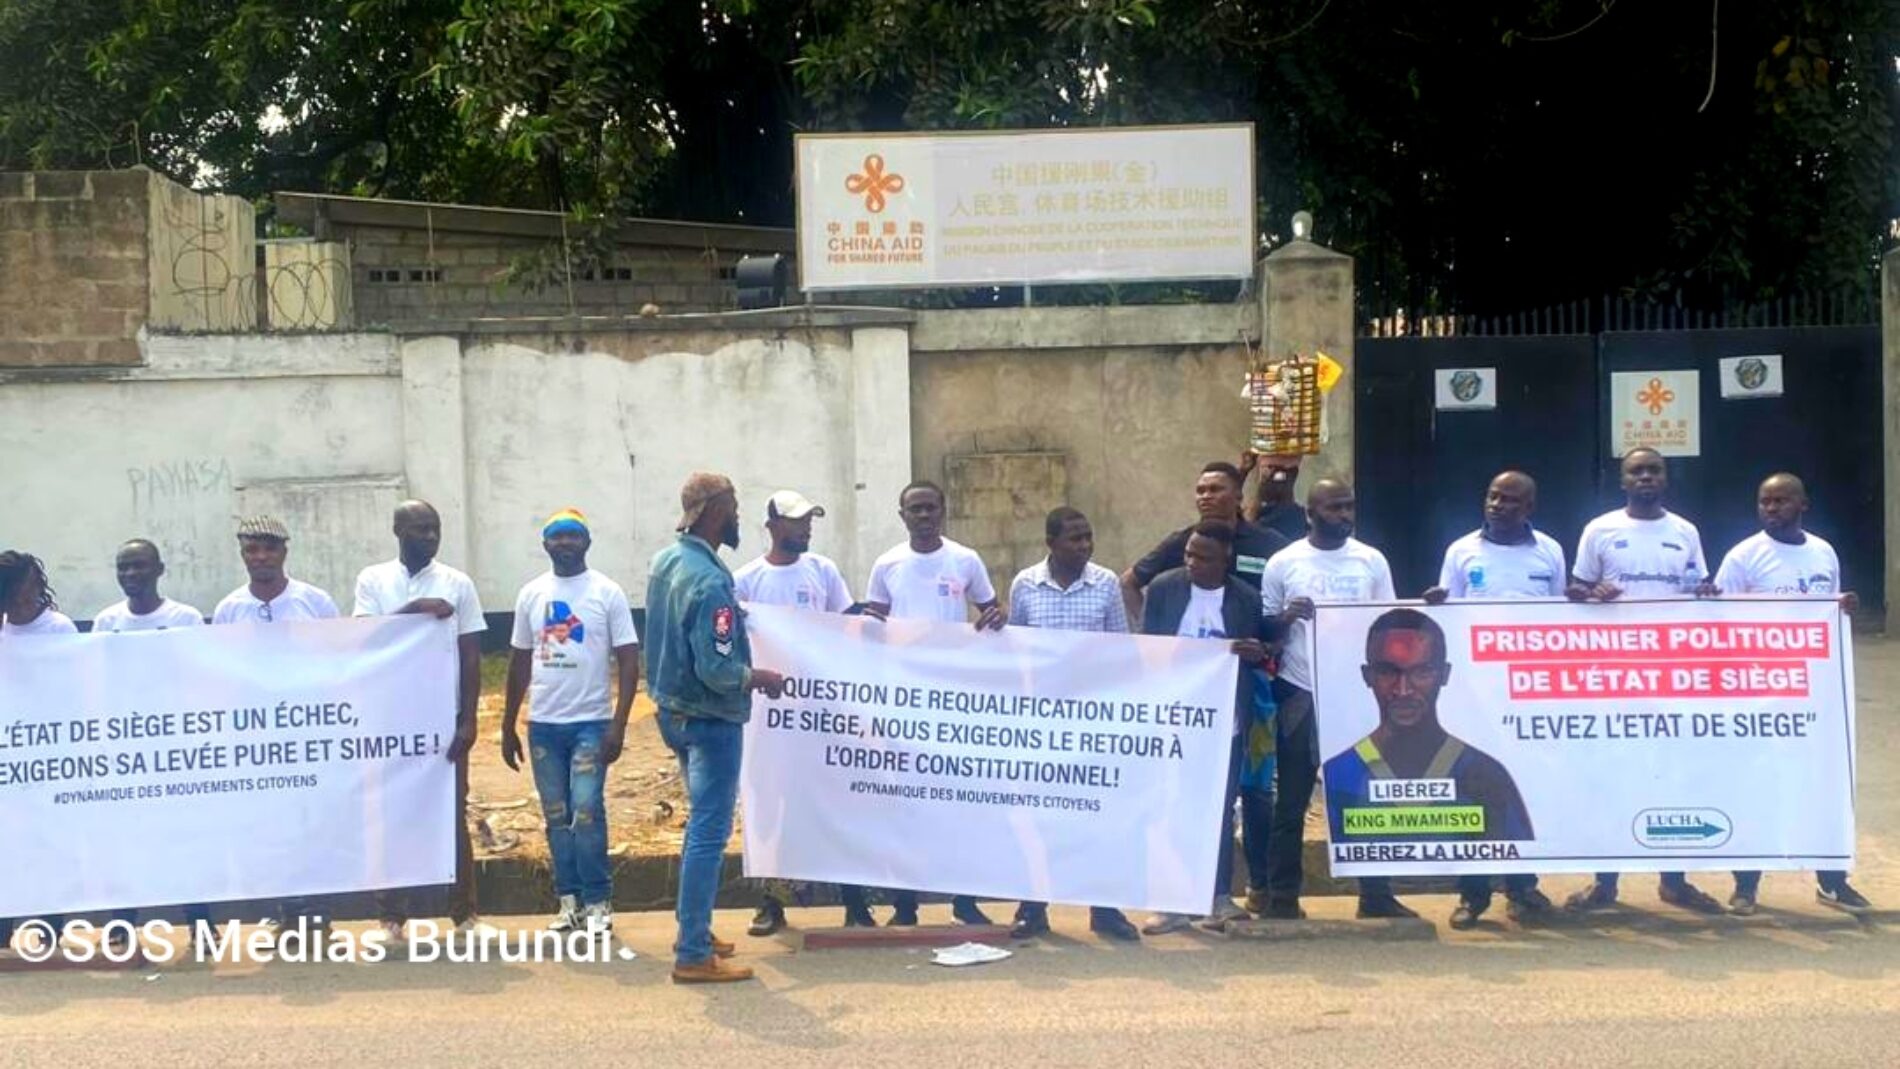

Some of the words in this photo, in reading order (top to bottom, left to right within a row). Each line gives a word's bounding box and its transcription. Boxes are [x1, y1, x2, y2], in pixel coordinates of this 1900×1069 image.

[828, 237, 885, 251] CHINA
[892, 237, 923, 250] AID
[1477, 630, 1660, 652] PRISONNIER
[1667, 626, 1825, 650] POLITIQUE
[1512, 670, 1550, 693] DE
[1561, 665, 1662, 692] L'ÉTAT
[1672, 669, 1712, 691] DE
[1720, 663, 1808, 690] SIÈGE
[783, 676, 888, 705] QUESTION
[895, 687, 922, 708] DE
[928, 690, 1114, 722] REQUALIFICATION
[1121, 703, 1149, 723] DE
[1155, 700, 1217, 729] L'ÉTAT
[70, 719, 100, 743] DE
[107, 711, 175, 740] SIÈGE
[183, 710, 226, 735] EST
[233, 708, 267, 731] UN
[275, 701, 359, 728] ÉCHEC,
[767, 708, 794, 729] DE
[800, 708, 865, 738] SIÈGE,
[871, 717, 930, 741] NOUS
[937, 723, 1042, 750] EXIGEONS
[1049, 730, 1074, 751] LE
[1079, 733, 1163, 759] RETOUR
[1169, 733, 1183, 760] À
[1606, 712, 1684, 739] L'ETAT
[1692, 713, 1725, 738] DE
[0, 754, 109, 785] EXIGEONS
[116, 751, 147, 775] SA
[154, 742, 227, 772] LEVÉE
[235, 741, 298, 767] PURE
[305, 739, 333, 763] ET
[340, 734, 426, 760] SIMPLE
[825, 745, 909, 772] L'ORDRE
[915, 752, 1120, 788] CONSTITUTIONNEL!
[54, 786, 136, 804] #DYNAMIQUE
[138, 784, 163, 799] DES
[166, 777, 254, 796] MOUVEMENTS
[256, 774, 318, 791] CITOYENS
[849, 780, 926, 800] #DYNAMIQUE
[930, 786, 955, 801] DES
[956, 789, 1040, 808] MOUVEMENTS
[1043, 796, 1101, 812] CITOYENS
[1374, 781, 1450, 799] LIBÉREZ
[1345, 814, 1386, 828] KING
[1390, 812, 1481, 828] MWAMISYO
[1646, 814, 1702, 826] LUCHA
[1335, 842, 1417, 861] LIBÉREZ
[1422, 844, 1449, 860] LA
[1453, 843, 1521, 860] LUCHA
